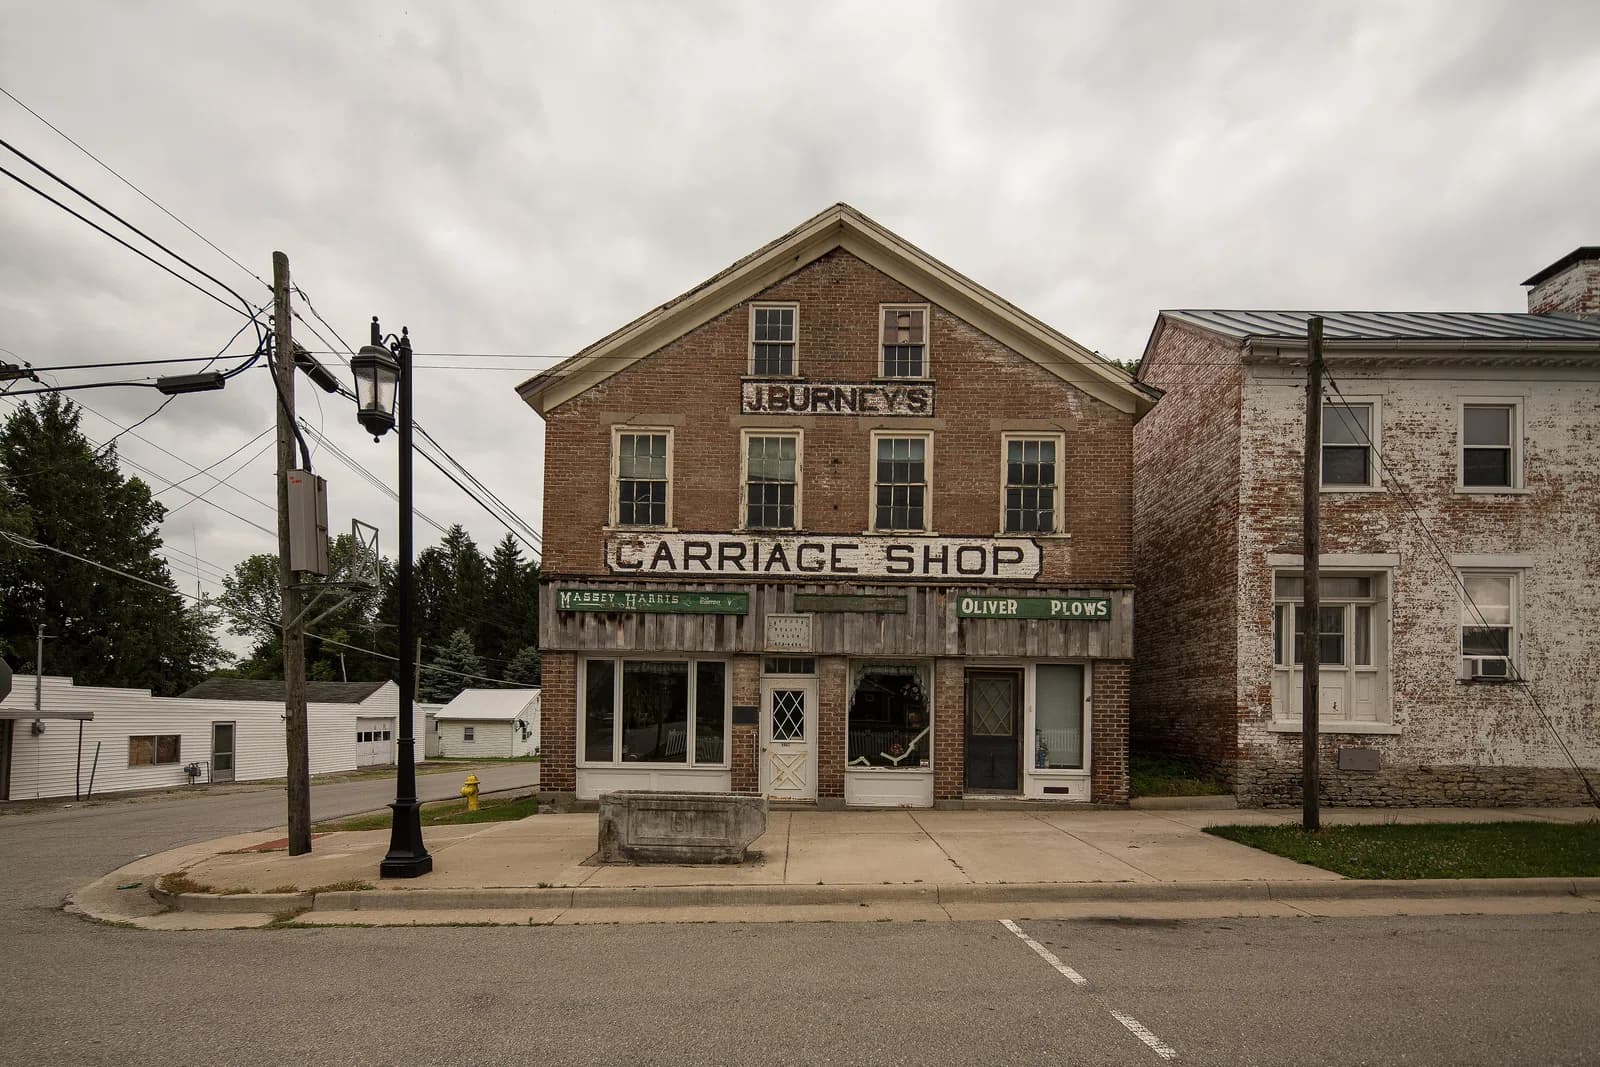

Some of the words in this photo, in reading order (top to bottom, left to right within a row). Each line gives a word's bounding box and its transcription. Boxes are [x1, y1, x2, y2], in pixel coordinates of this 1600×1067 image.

[616, 540, 859, 574] CARRIAGE
[886, 544, 1025, 576] SHOP
[560, 592, 615, 608] MASSEY
[624, 593, 680, 609] HARRIS
[961, 598, 1018, 615] OLIVER
[1051, 600, 1108, 616] PLOWS
